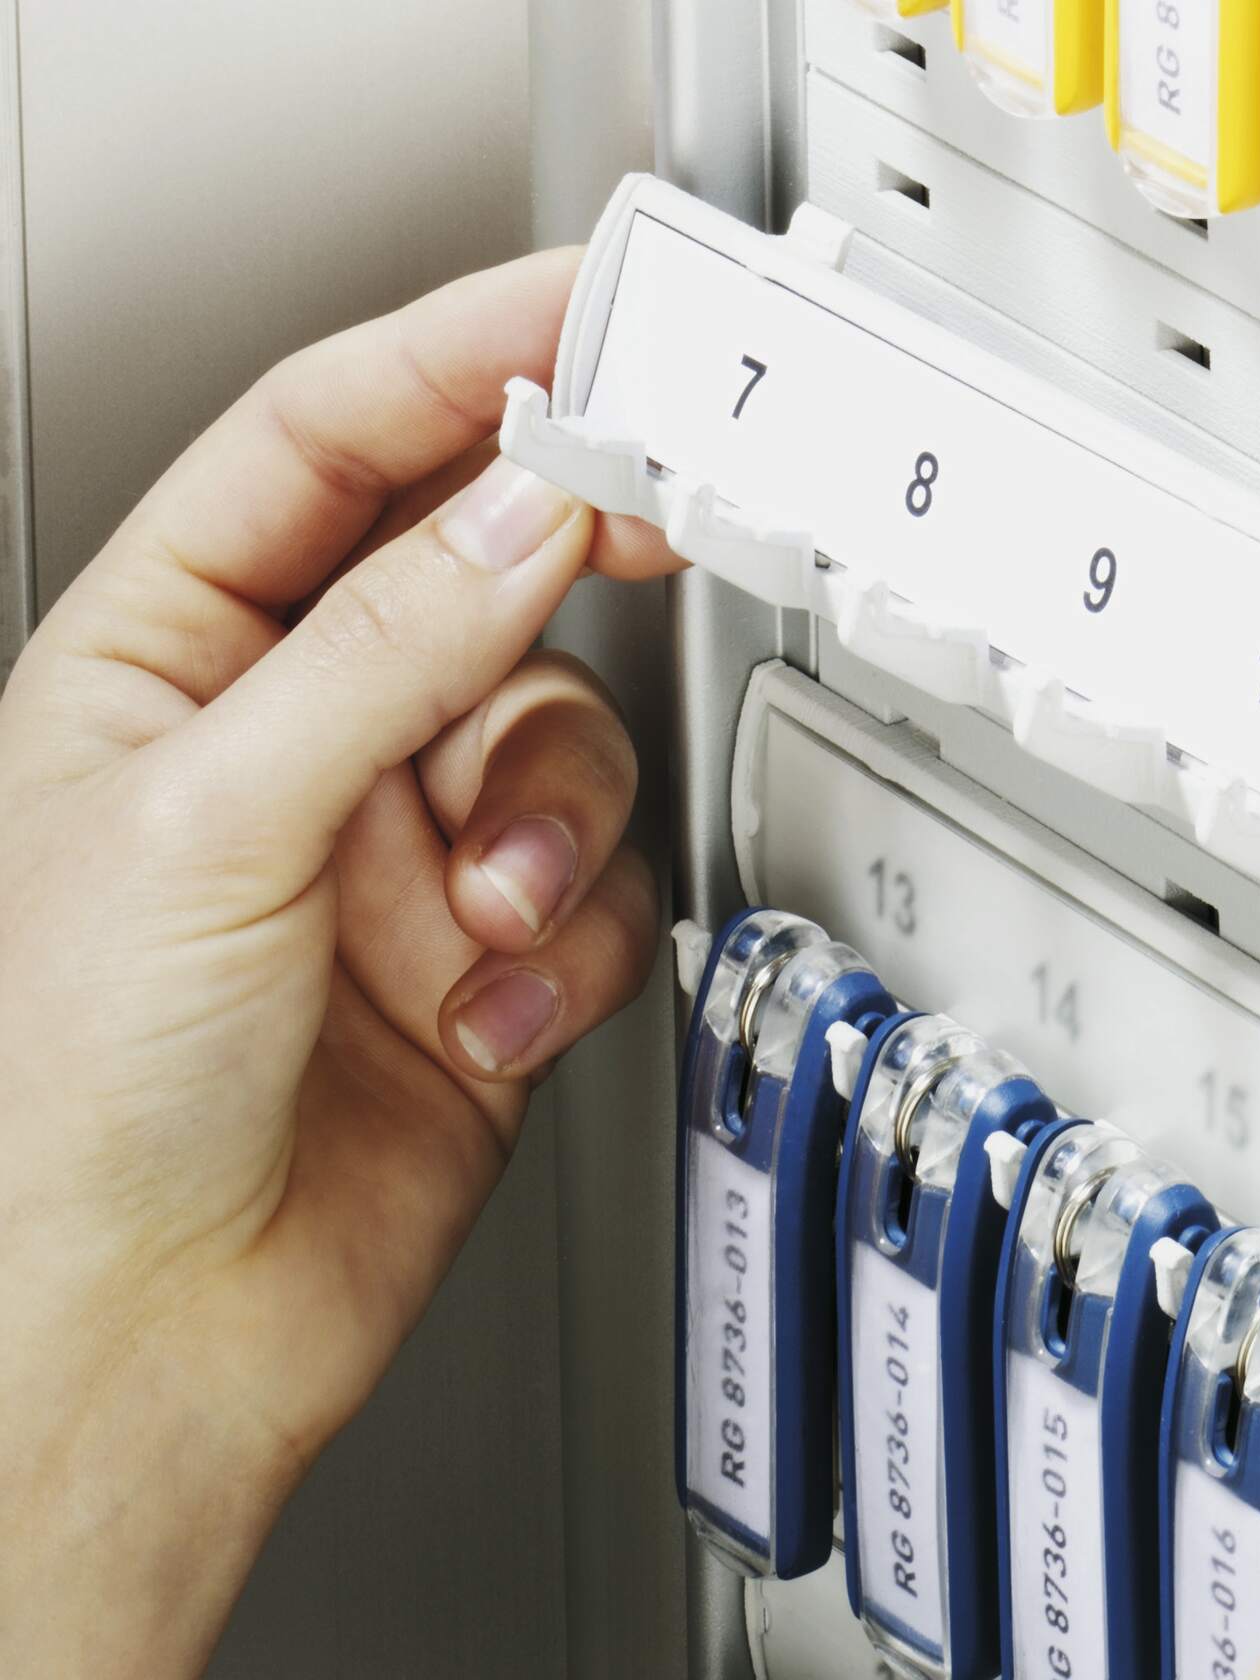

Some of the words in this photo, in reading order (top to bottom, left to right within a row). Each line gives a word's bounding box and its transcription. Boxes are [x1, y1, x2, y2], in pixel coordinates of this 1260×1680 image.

[1157, 45, 1180, 115] RG
[732, 354, 767, 419] 7
[906, 452, 938, 517] 8
[1084, 548, 1116, 613] 9
[866, 858, 917, 937] 13
[1031, 962, 1080, 1044] 14
[1198, 1068, 1250, 1152] 15
[722, 1189, 748, 1408] 8736-013
[886, 1306, 911, 1519] 8736-014
[721, 1419, 746, 1489] RG
[1043, 1415, 1069, 1634] 8736-015
[891, 1530, 918, 1599] RG
